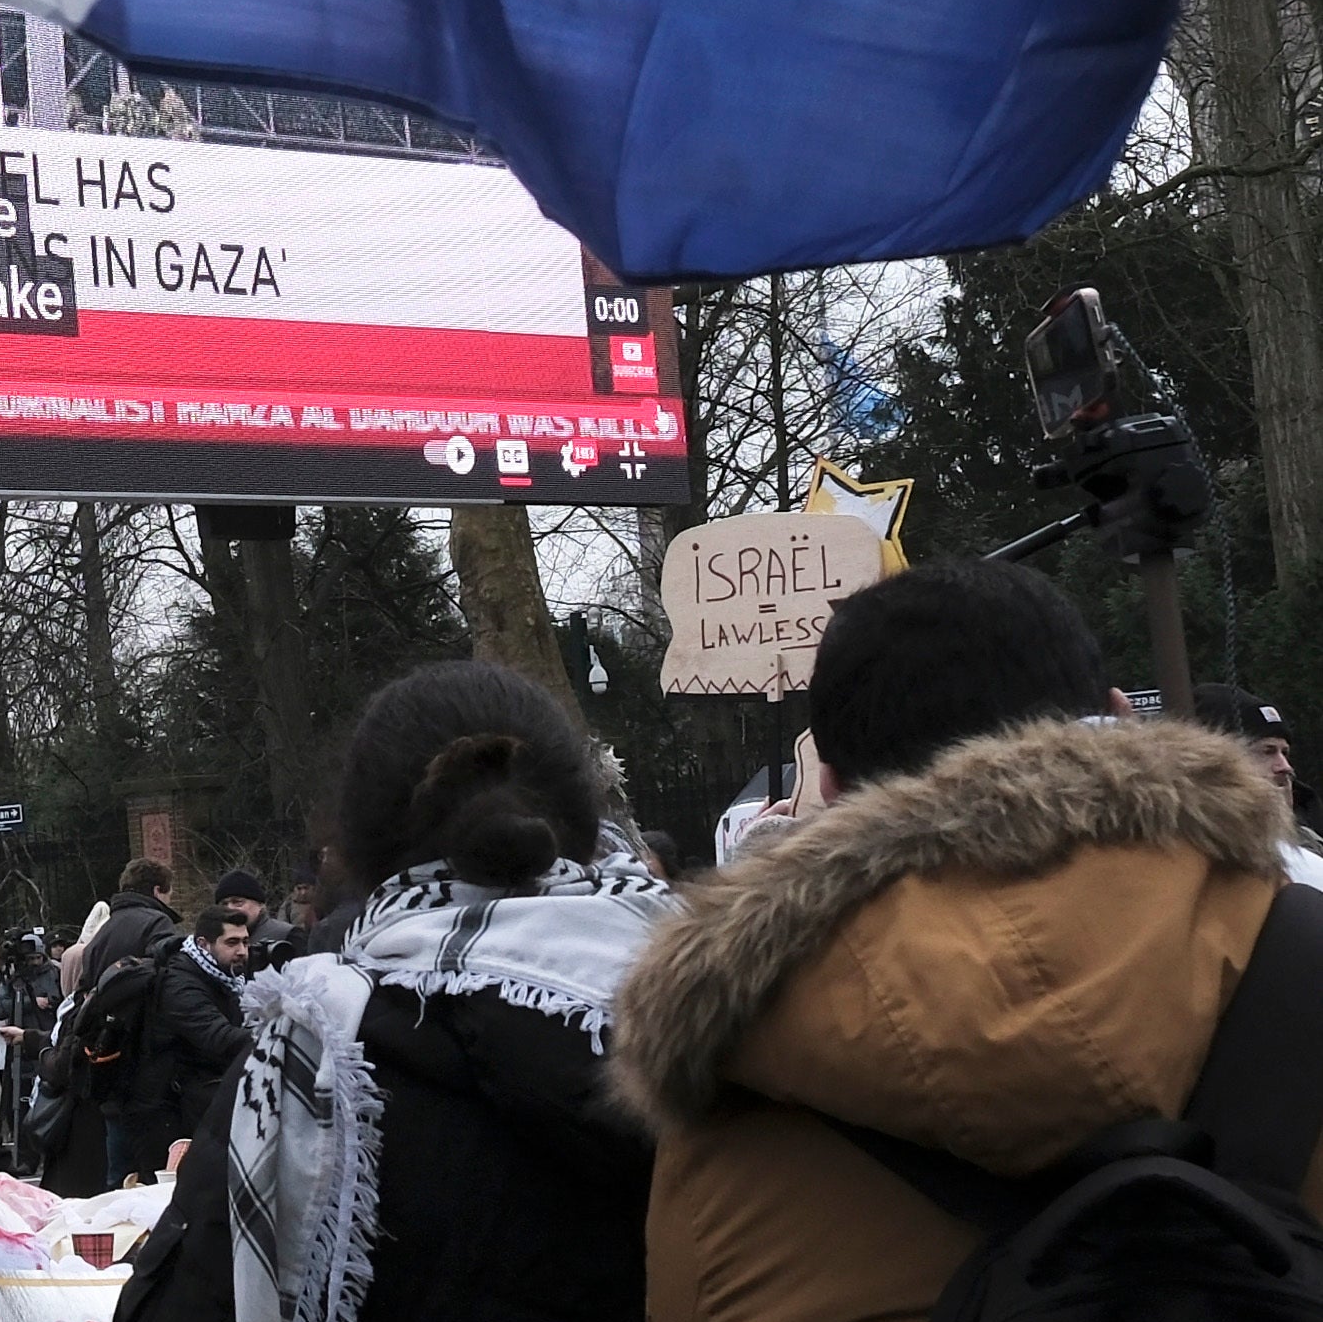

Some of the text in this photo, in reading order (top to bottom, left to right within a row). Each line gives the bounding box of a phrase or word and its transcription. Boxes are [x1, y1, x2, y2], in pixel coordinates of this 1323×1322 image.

[76, 157, 176, 213] HAS
[90, 236, 136, 289] IN
[155, 241, 287, 298] GAZA'
[595, 296, 640, 323] 0:00
